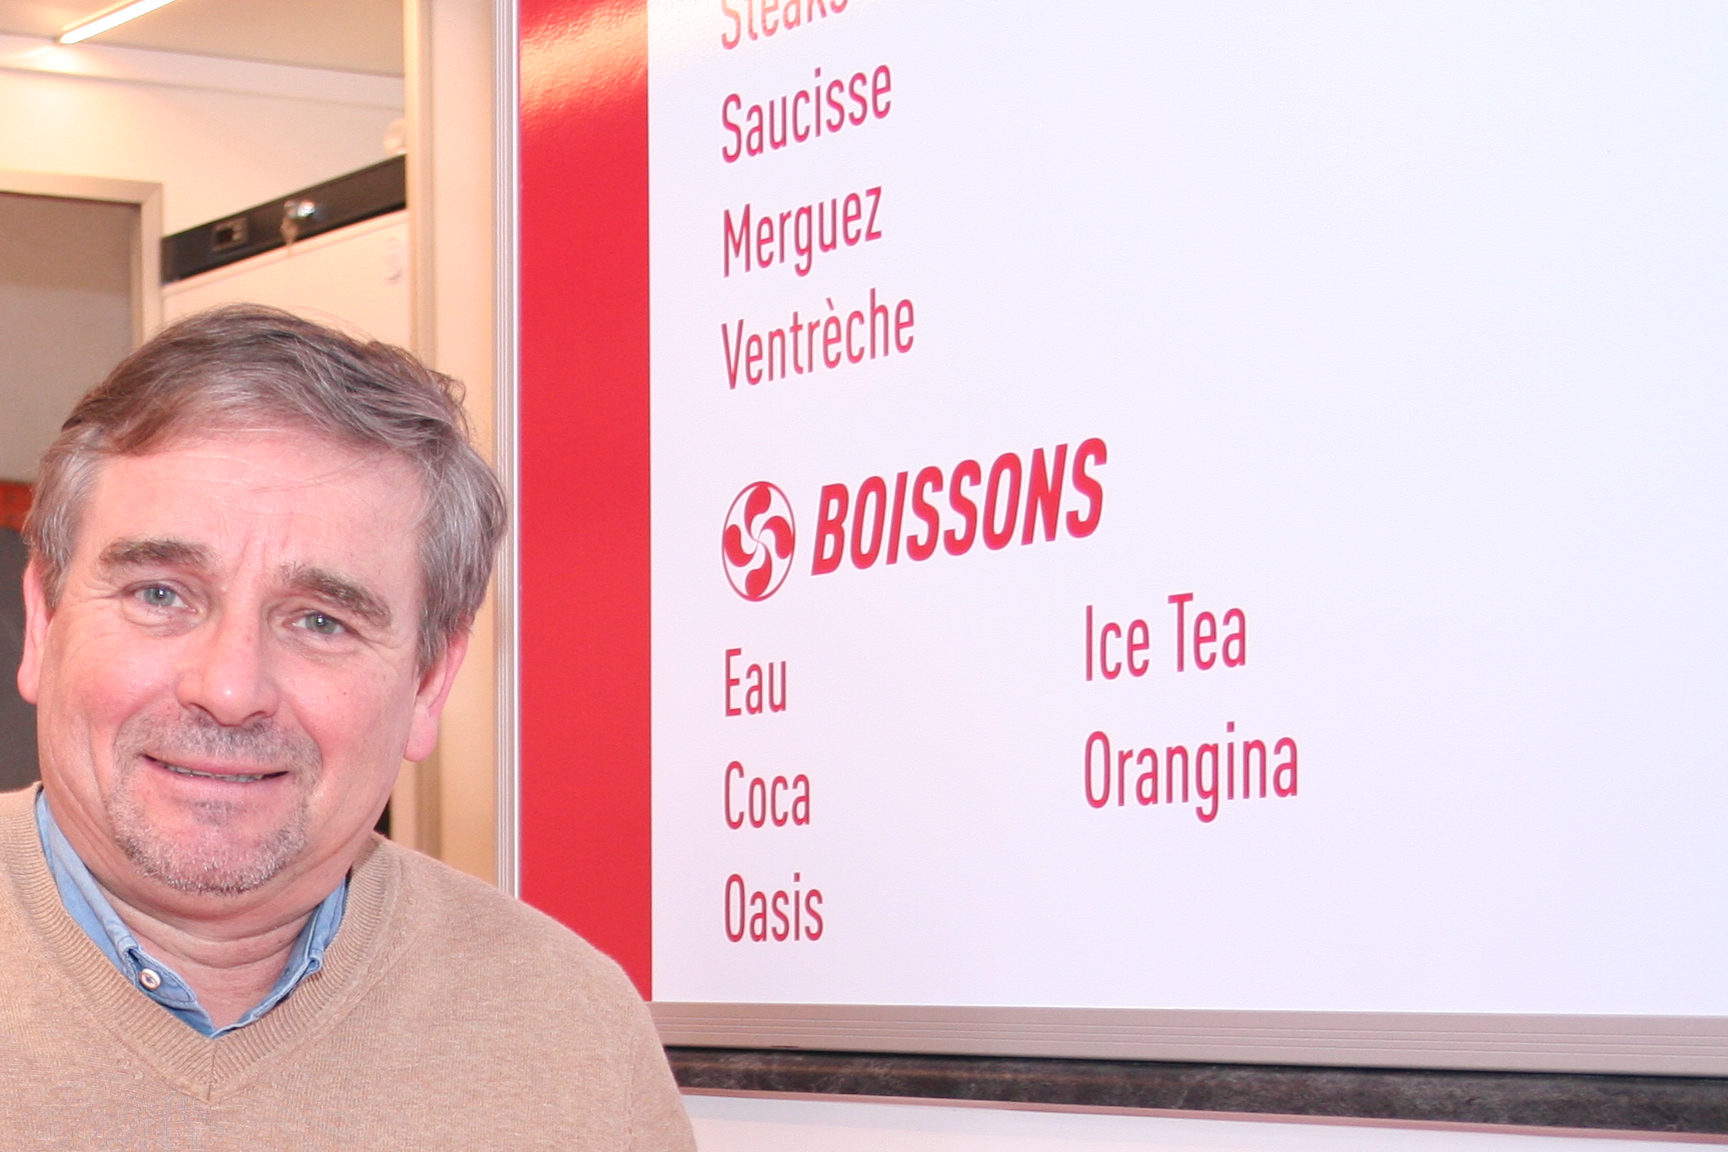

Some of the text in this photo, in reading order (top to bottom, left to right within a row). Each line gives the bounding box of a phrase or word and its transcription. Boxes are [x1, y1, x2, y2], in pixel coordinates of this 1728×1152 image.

[721, 0, 849, 50] Stea
[721, 64, 892, 164] Saucisse
[722, 185, 883, 278] Merguez
[721, 287, 915, 390] Ventrèche
[811, 437, 1108, 576] BOISSONS
[724, 647, 788, 717] Eau
[1085, 592, 1248, 682] Ice Tea
[724, 760, 812, 830] Coca
[1083, 720, 1299, 824] Orangina
[723, 872, 824, 943] Oasis
